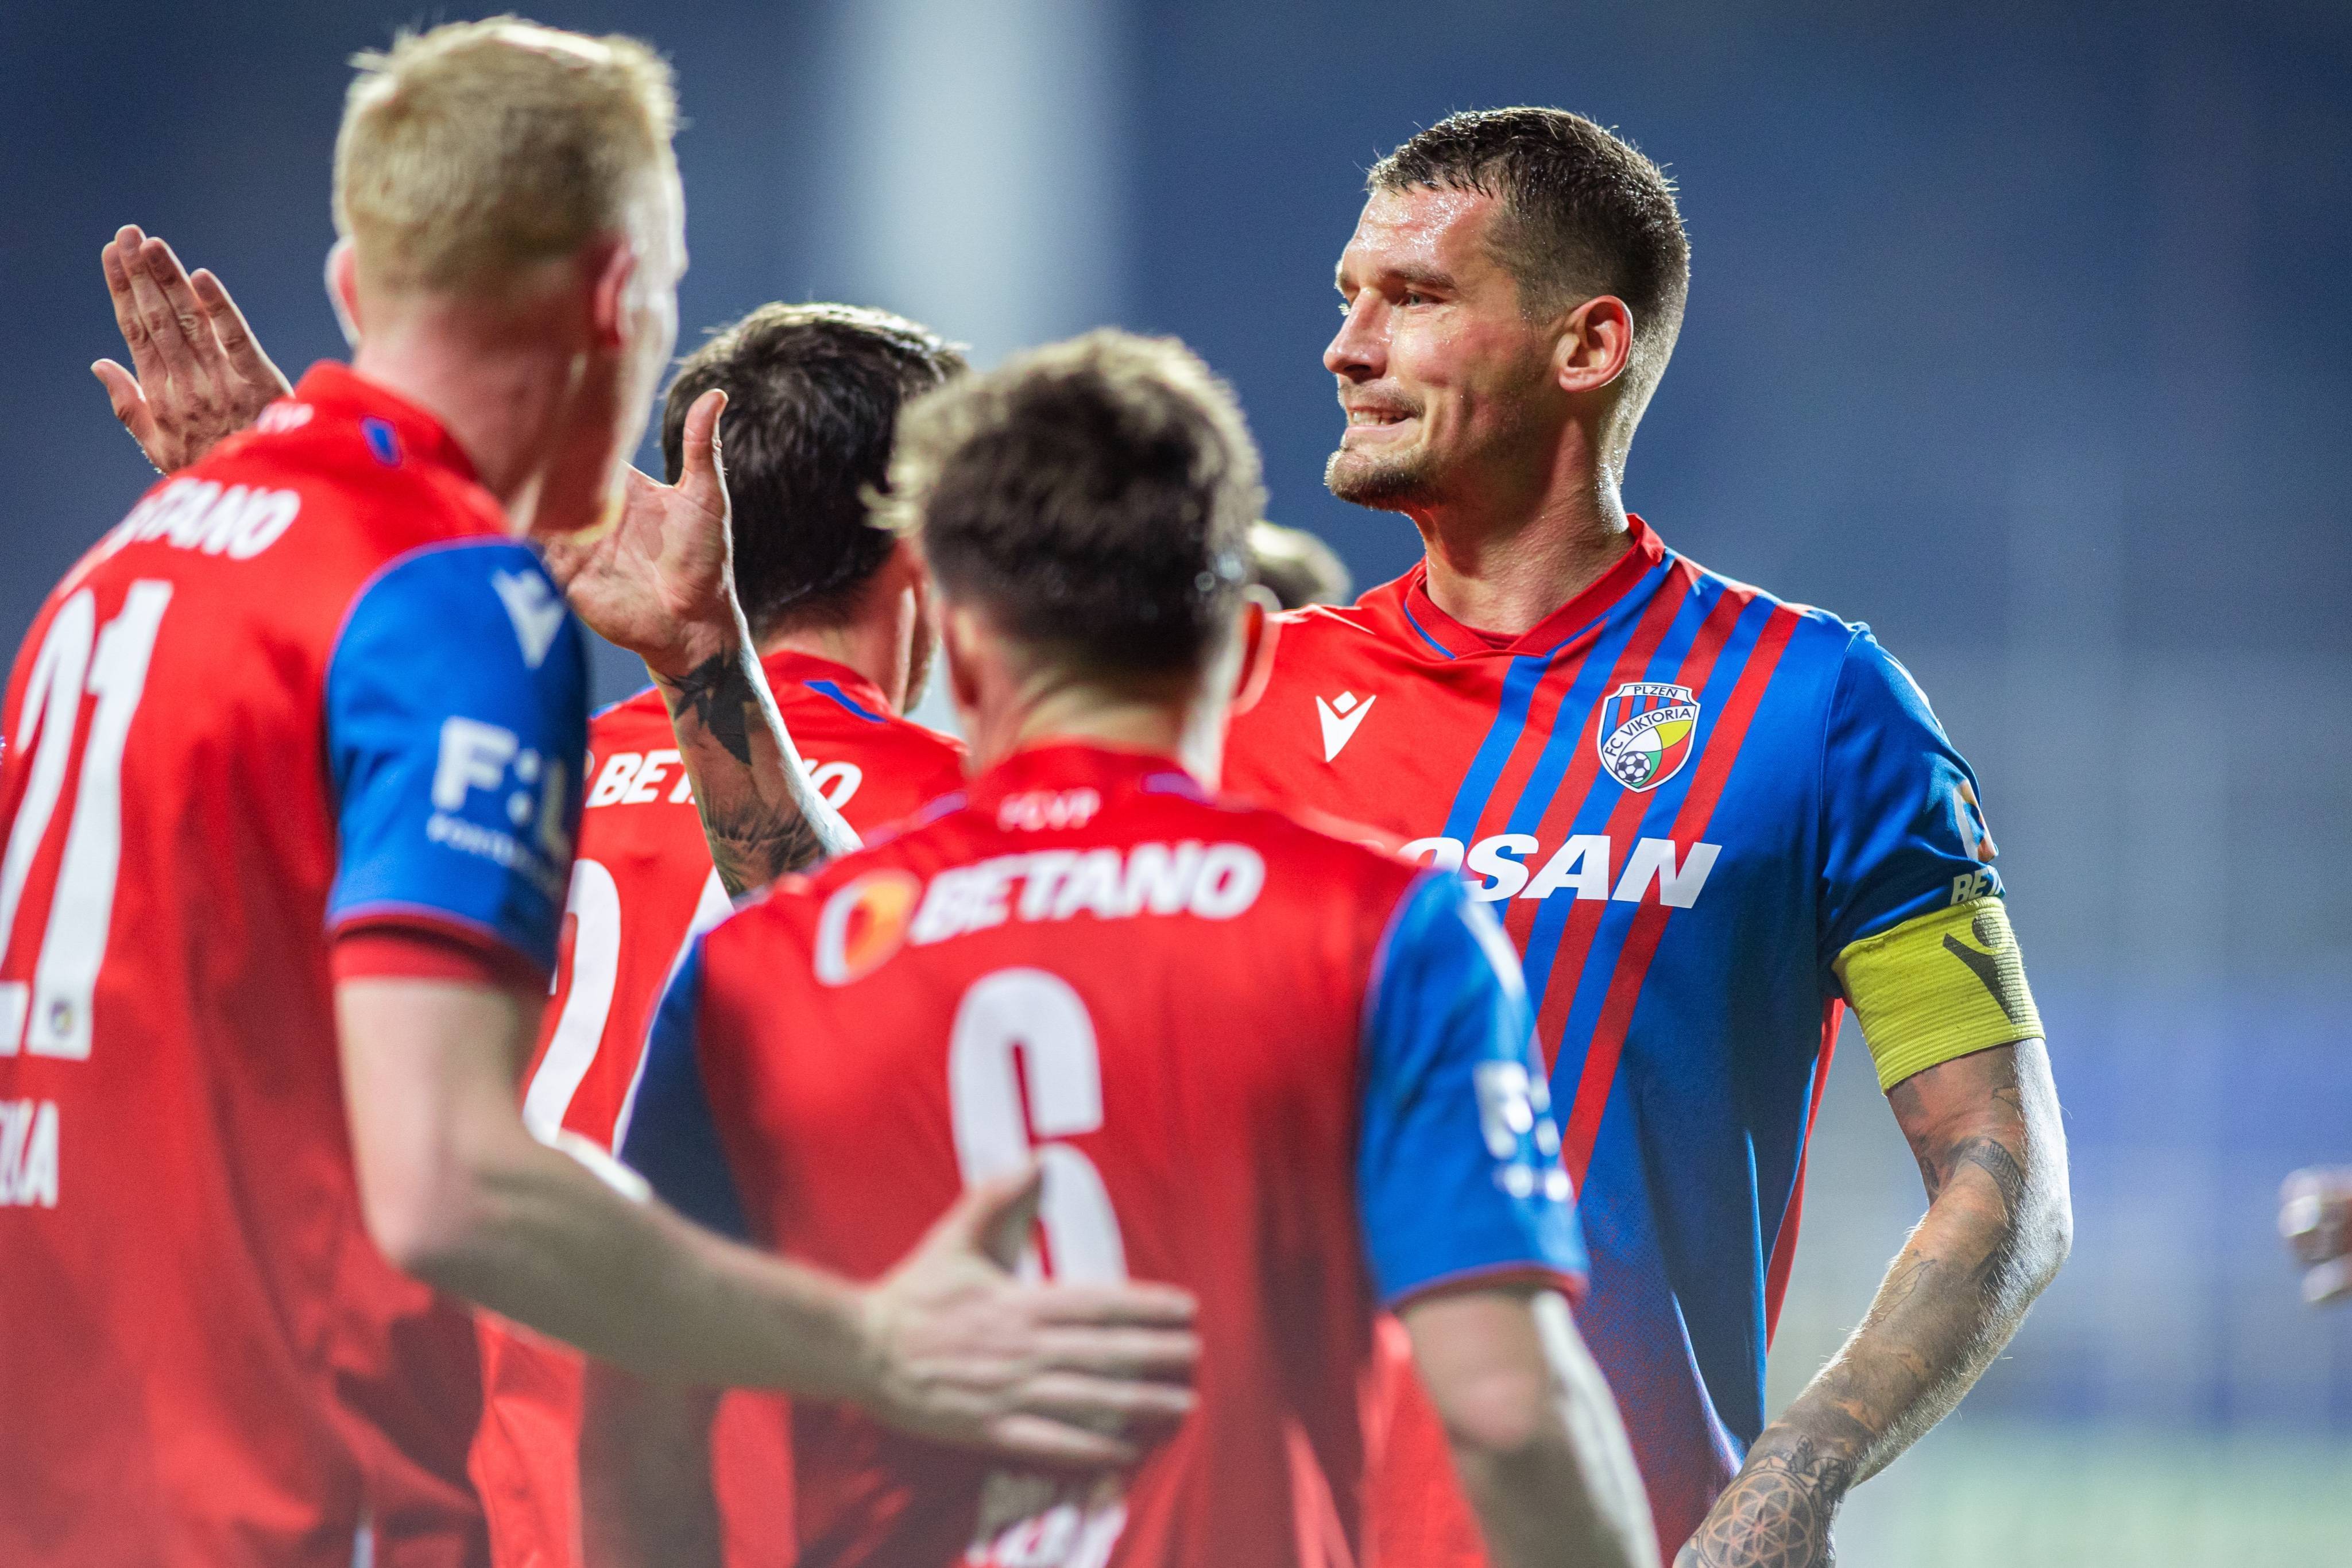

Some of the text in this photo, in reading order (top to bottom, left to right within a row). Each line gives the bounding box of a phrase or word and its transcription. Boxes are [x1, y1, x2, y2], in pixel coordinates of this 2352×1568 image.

[1604, 708, 1692, 756] FC VIKTORIA
[909, 840, 1266, 946] BETANO
[948, 966, 1129, 1286] 6
